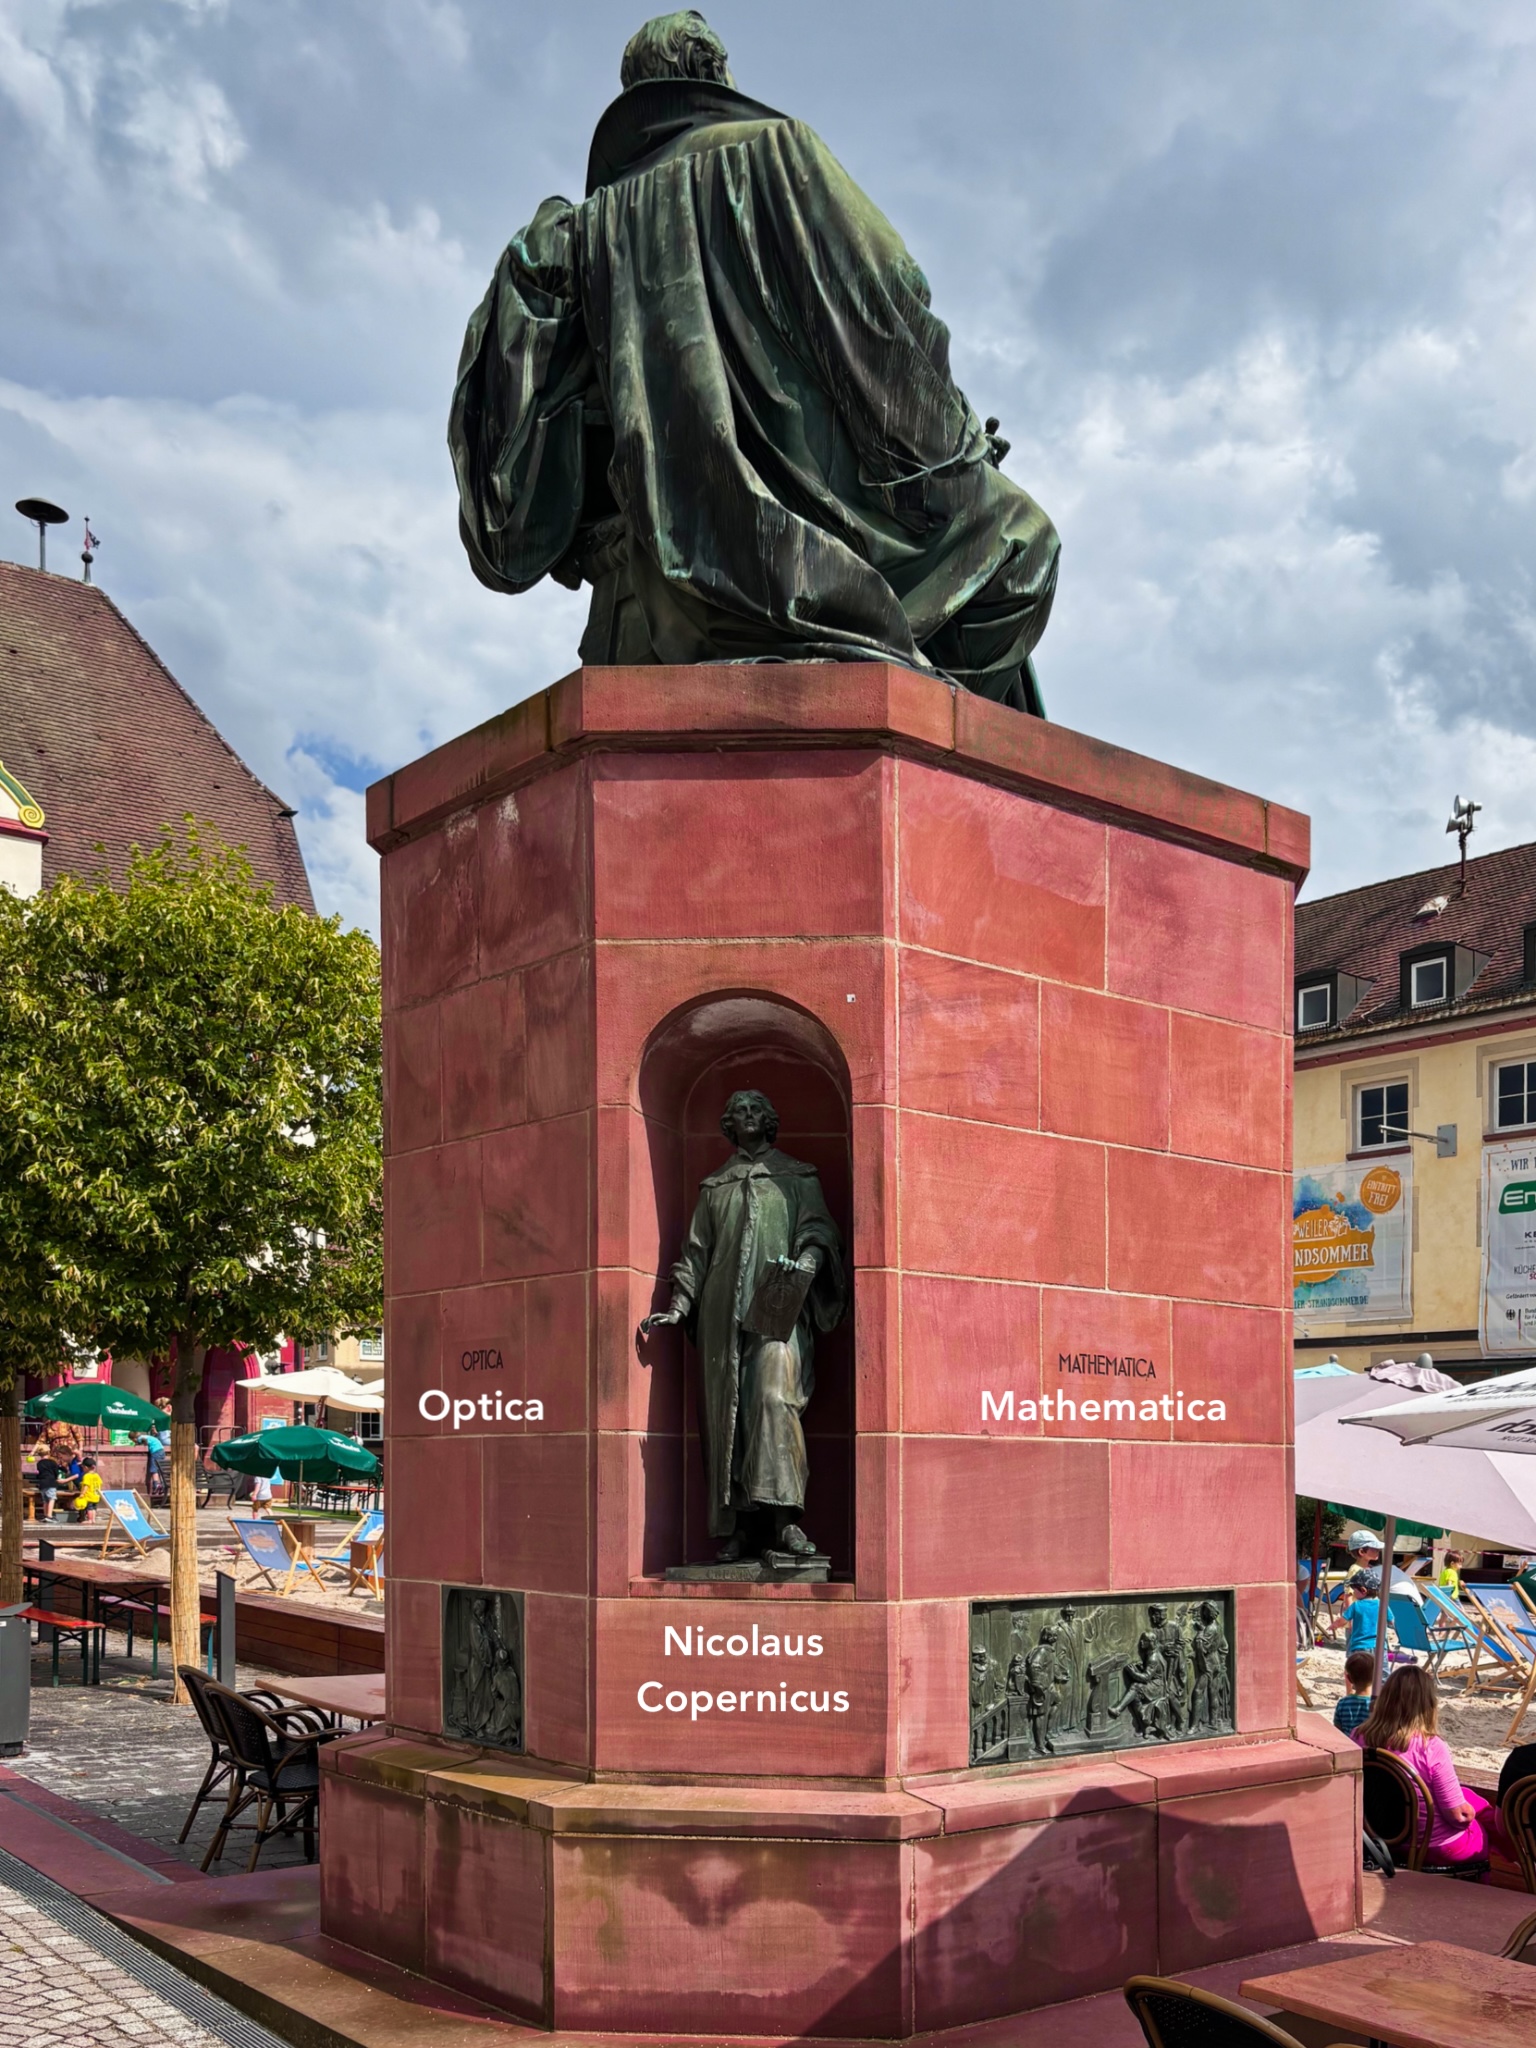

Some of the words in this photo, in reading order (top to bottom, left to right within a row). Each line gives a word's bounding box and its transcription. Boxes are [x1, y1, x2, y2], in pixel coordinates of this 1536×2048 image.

[1511, 1158, 1529, 1171] WIR
[1366, 1179, 1397, 1194] EINTRITT
[1368, 1191, 1389, 1207] FREI
[1294, 1243, 1369, 1267] NDSOMMER
[461, 1349, 504, 1371] OPTICA
[1058, 1352, 1157, 1380] MATHEMATICA
